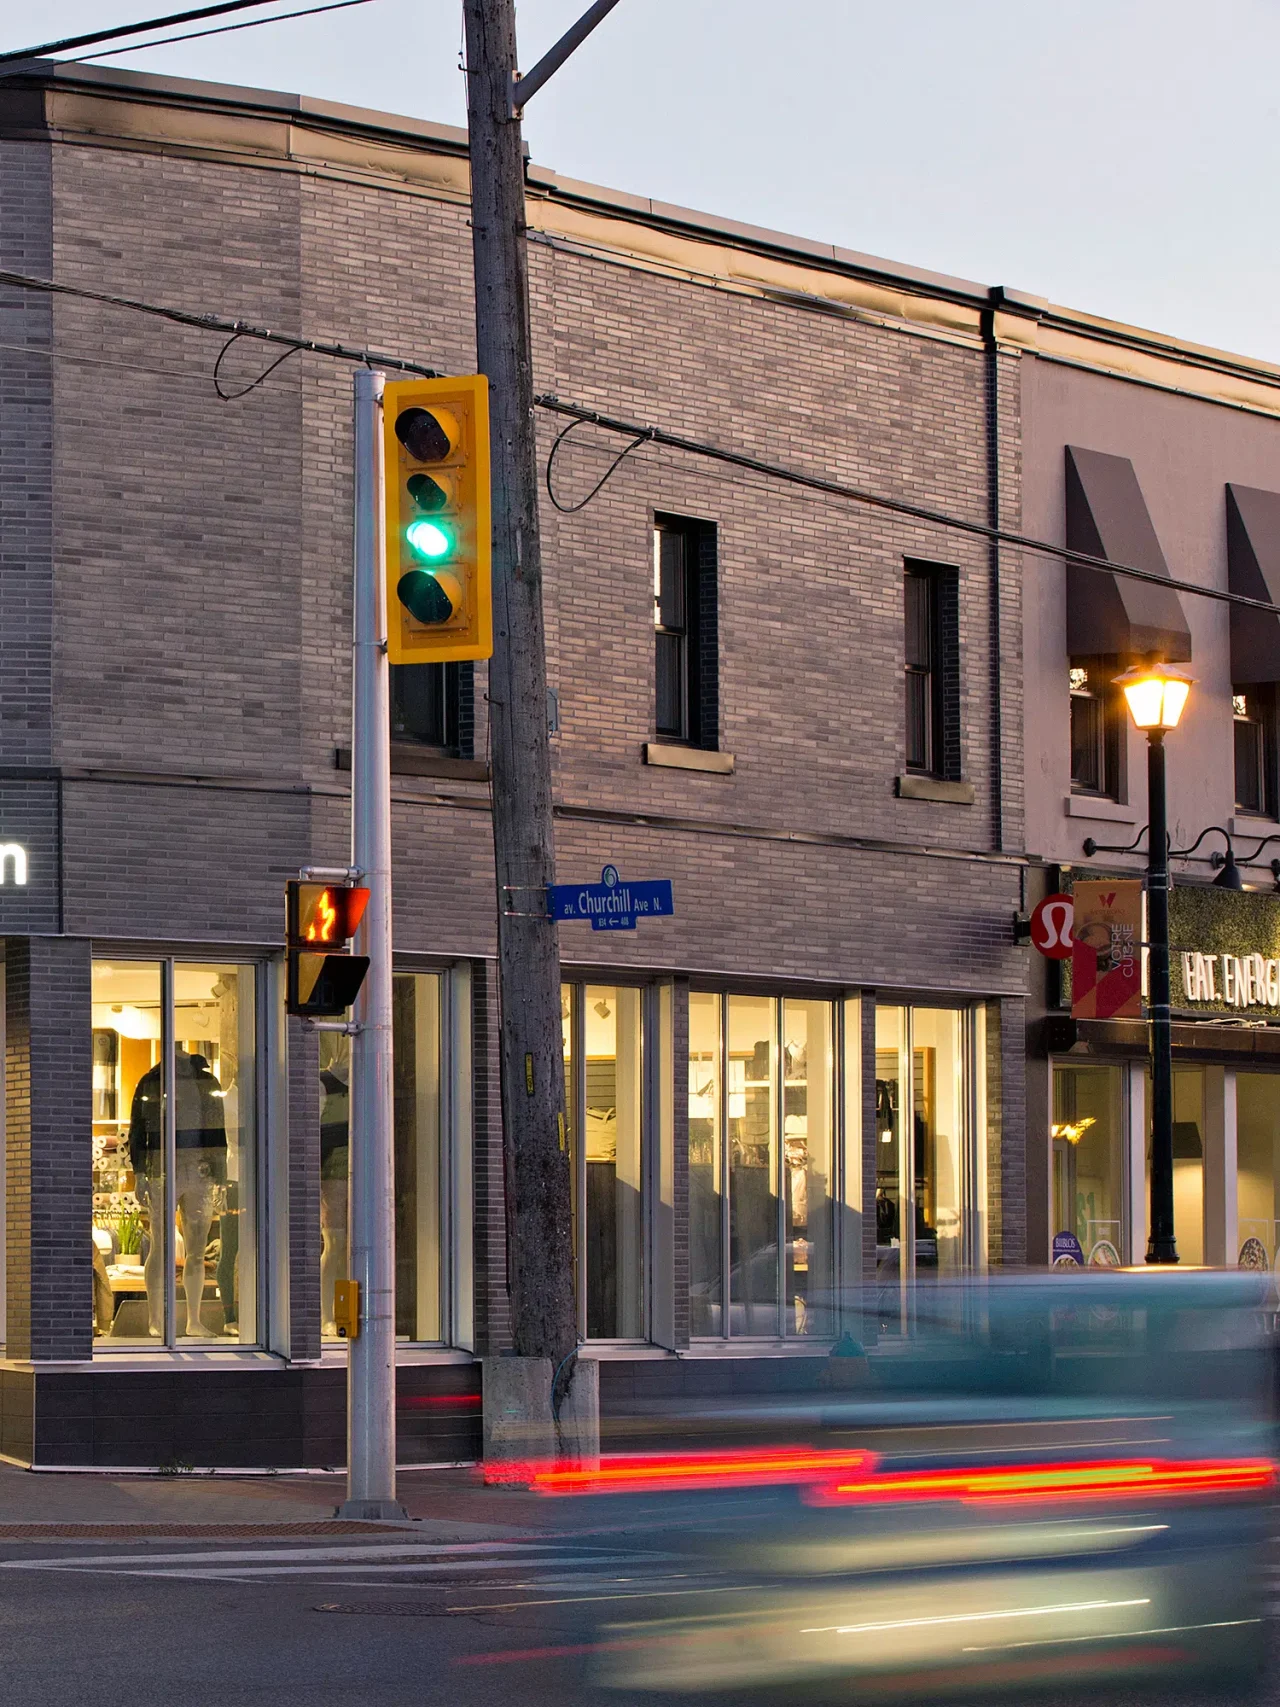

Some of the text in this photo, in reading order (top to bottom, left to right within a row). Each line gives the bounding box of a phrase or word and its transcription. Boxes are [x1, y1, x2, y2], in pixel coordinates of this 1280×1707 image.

[564, 888, 662, 915] av. Churchill Ave N.
[1111, 923, 1123, 971] VOTRE
[1180, 951, 1222, 1001] EAT.
